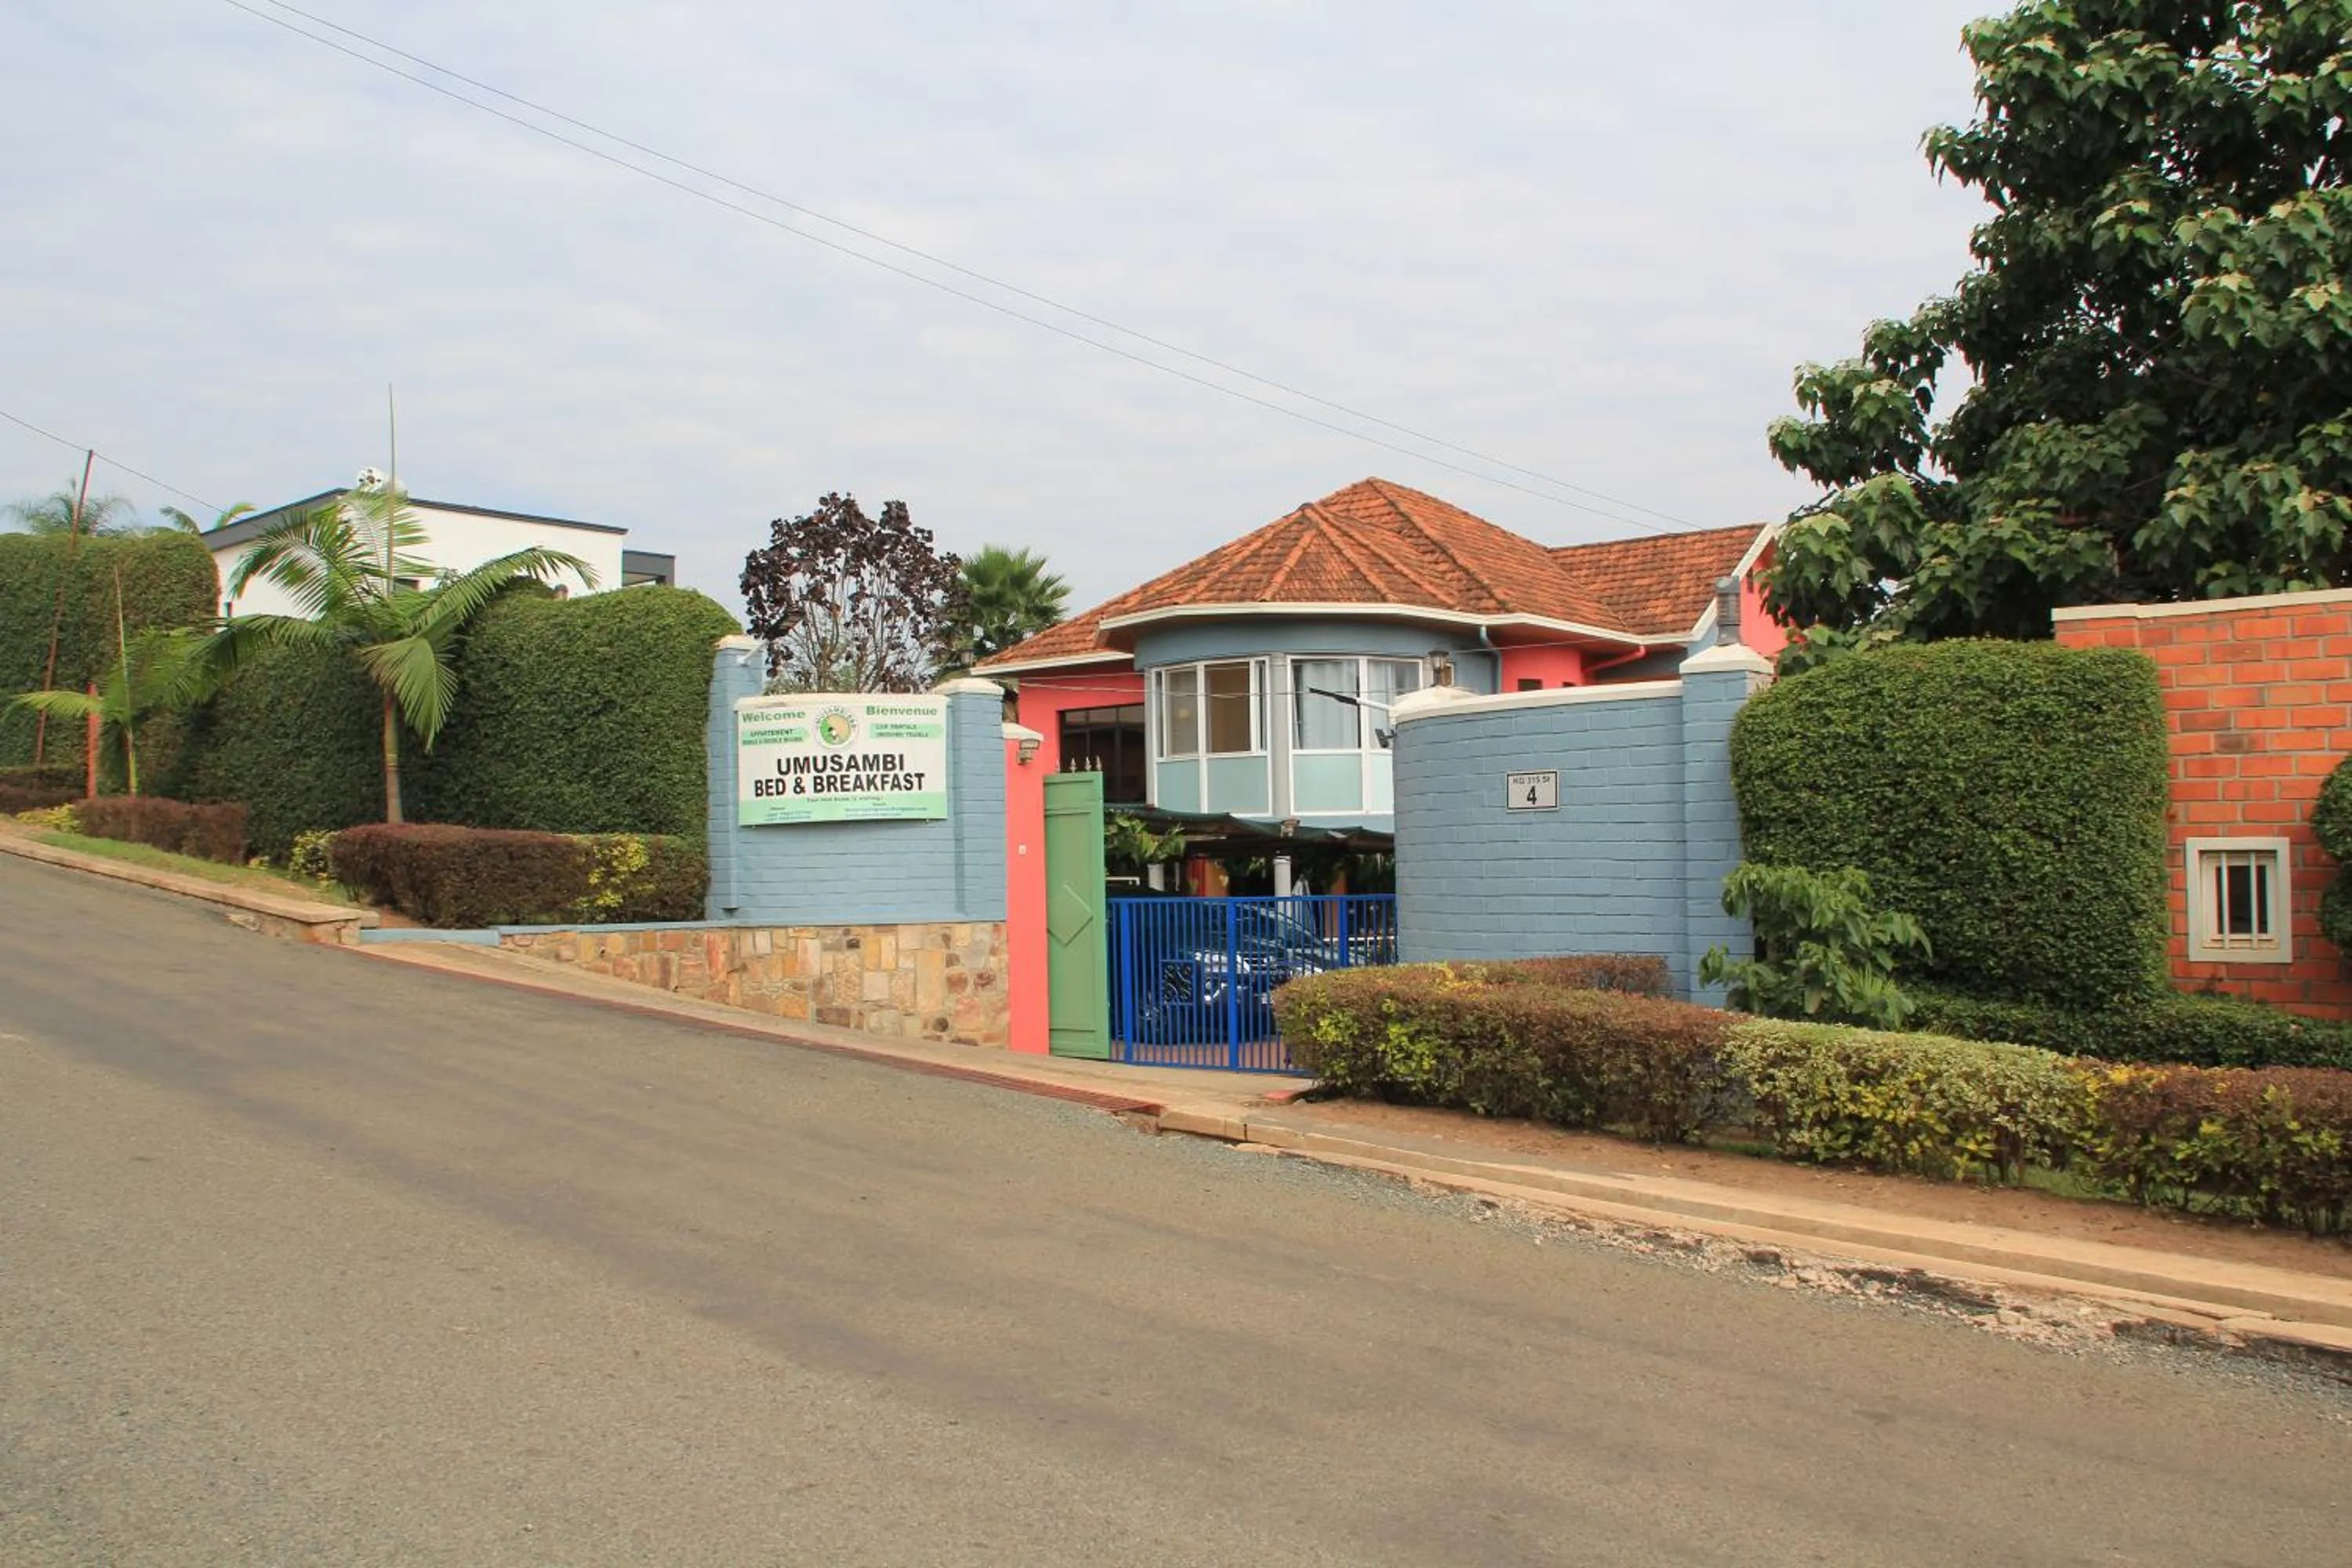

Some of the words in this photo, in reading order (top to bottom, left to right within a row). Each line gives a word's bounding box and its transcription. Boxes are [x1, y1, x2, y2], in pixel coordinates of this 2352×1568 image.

[742, 711, 806, 723] Welcome
[866, 705, 938, 716] Bienvenue
[777, 753, 904, 775] UMUSAMBI
[754, 779, 786, 797] BED
[793, 777, 806, 794] &
[813, 772, 925, 793] BREAKFAST
[1526, 786, 1537, 804] 4
